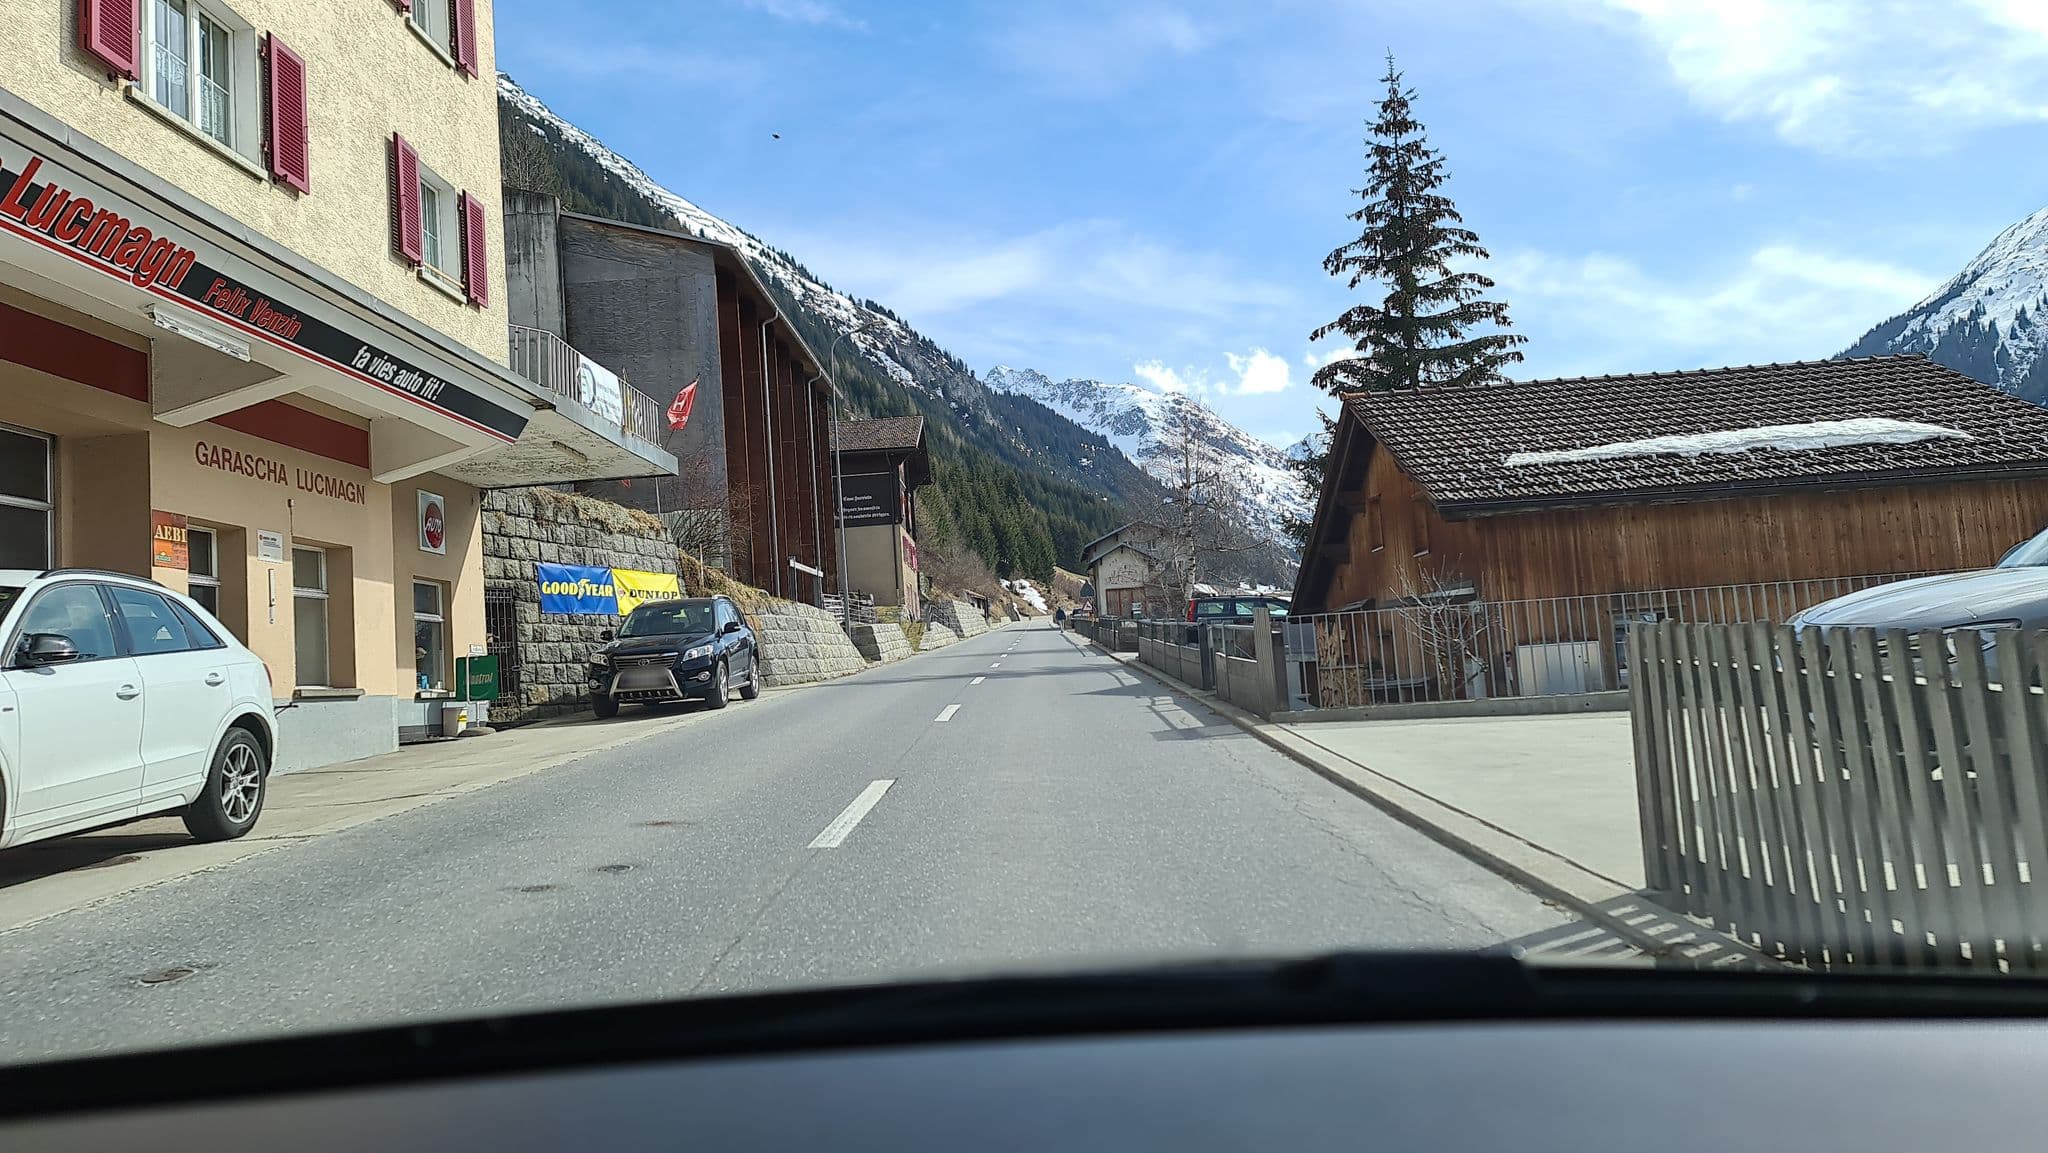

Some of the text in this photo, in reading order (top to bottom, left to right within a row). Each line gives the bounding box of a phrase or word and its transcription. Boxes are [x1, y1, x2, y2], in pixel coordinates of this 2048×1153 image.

[0, 156, 196, 287] Lucmagn
[203, 278, 302, 340] Felix Venzin
[368, 355, 397, 382] vies
[393, 367, 422, 393] auto
[420, 379, 446, 401] fit!
[195, 441, 365, 505] GARASCHA LUCMAGN
[154, 524, 187, 543] AEBI
[629, 588, 678, 600] DUNLOP
